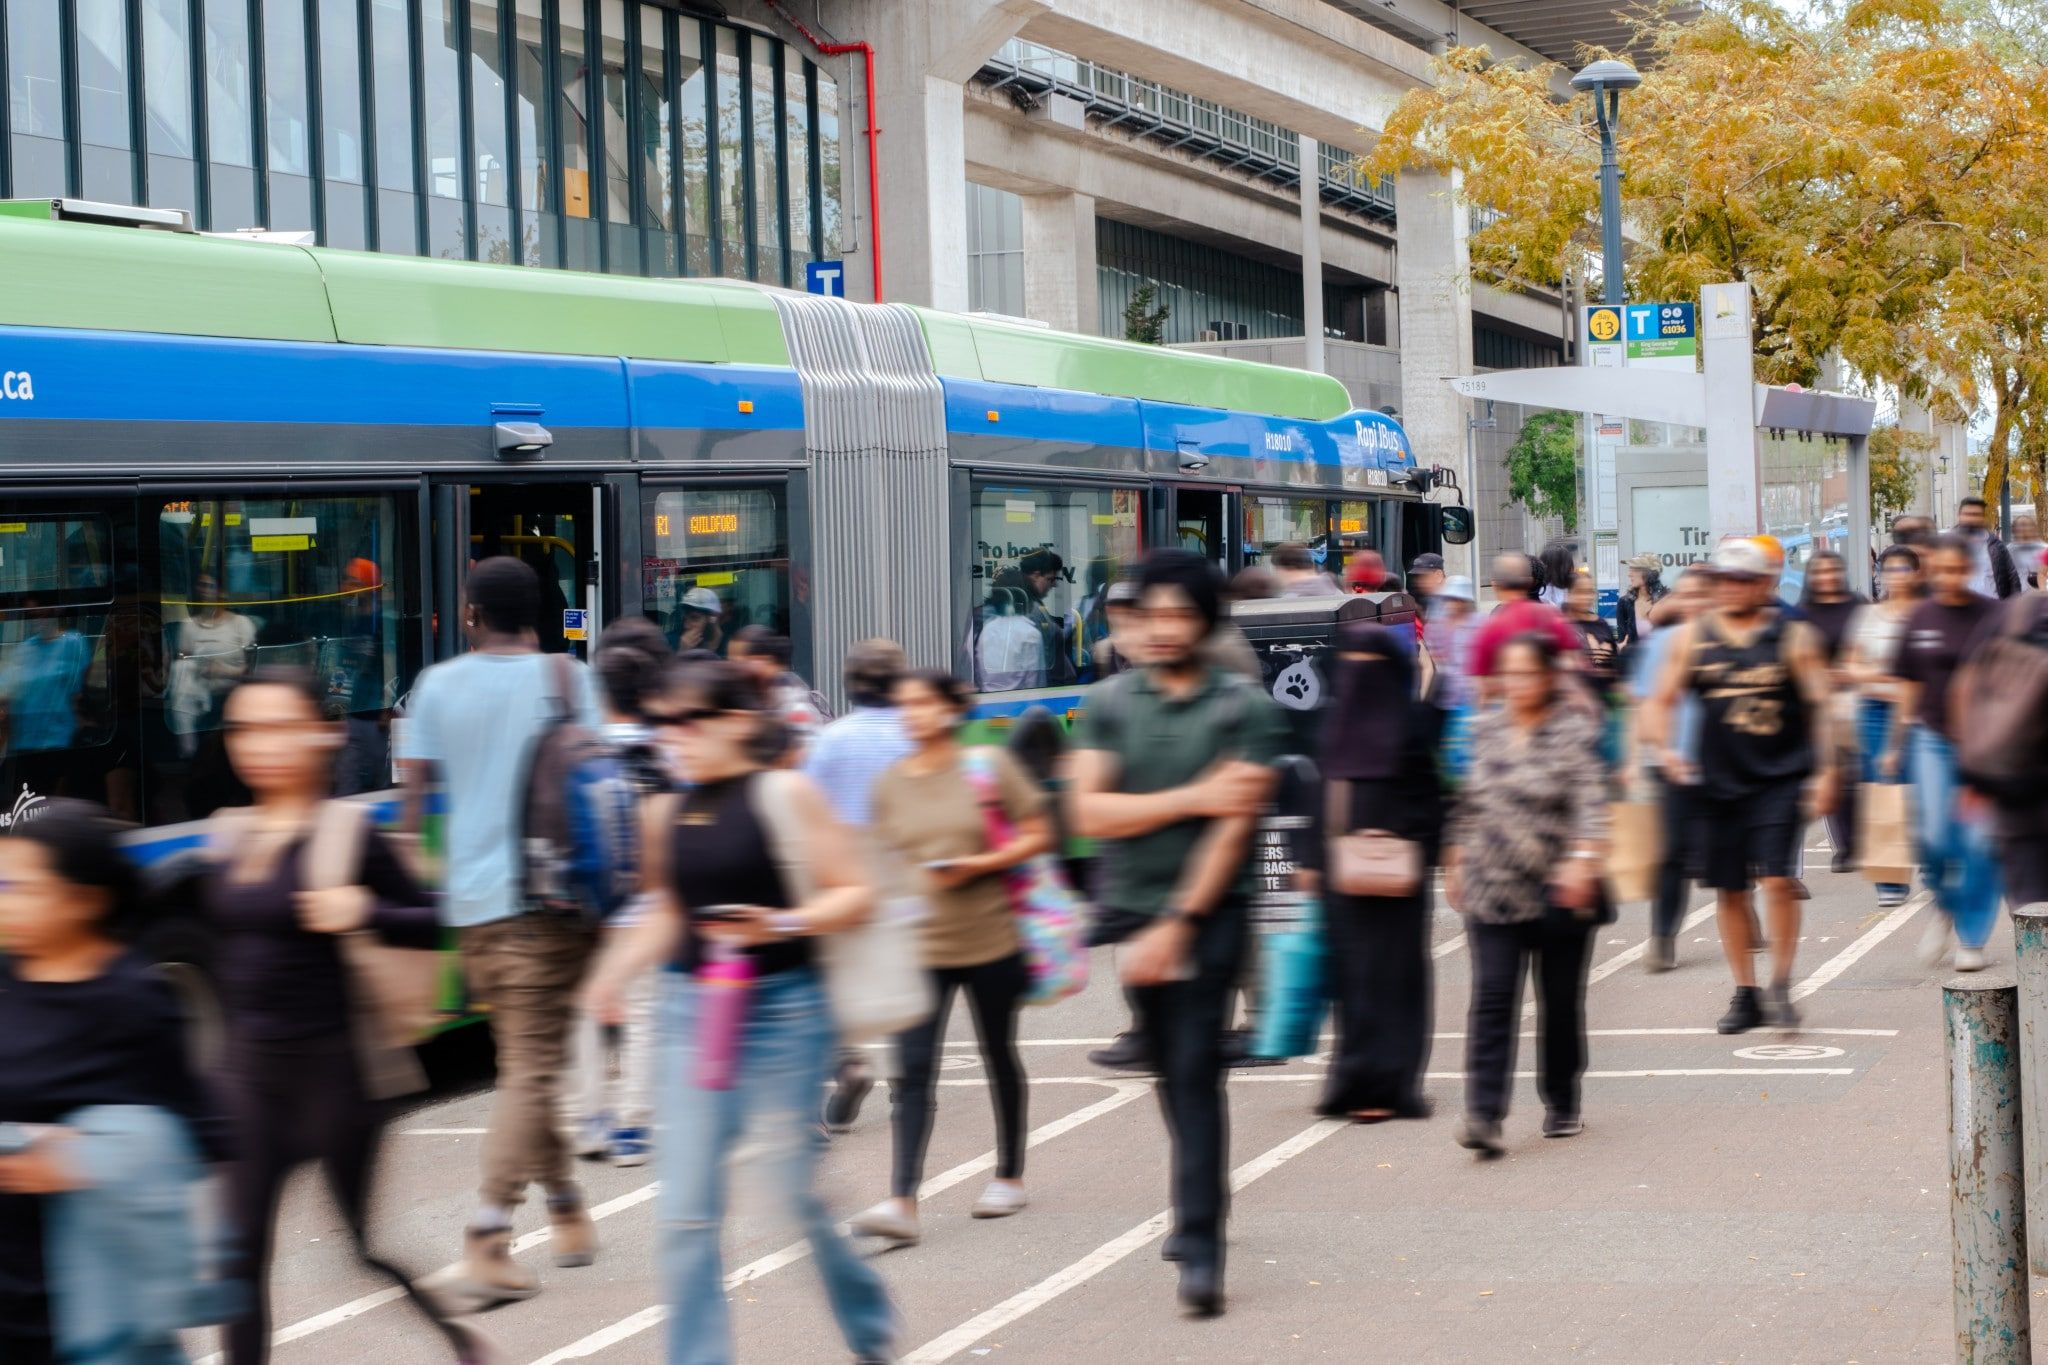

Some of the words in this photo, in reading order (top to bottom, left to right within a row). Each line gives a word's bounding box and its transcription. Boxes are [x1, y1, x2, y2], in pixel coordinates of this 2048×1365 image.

[815, 269, 841, 297] T
[1597, 312, 1610, 321] Bay
[1631, 310, 1651, 334] T
[1595, 321, 1614, 336] 13
[1662, 325, 1686, 334] 61036
[1461, 381, 1485, 392] 75189
[1265, 432, 1292, 452] H18010
[657, 515, 669, 536] R1
[690, 514, 736, 534] GUILDFORD
